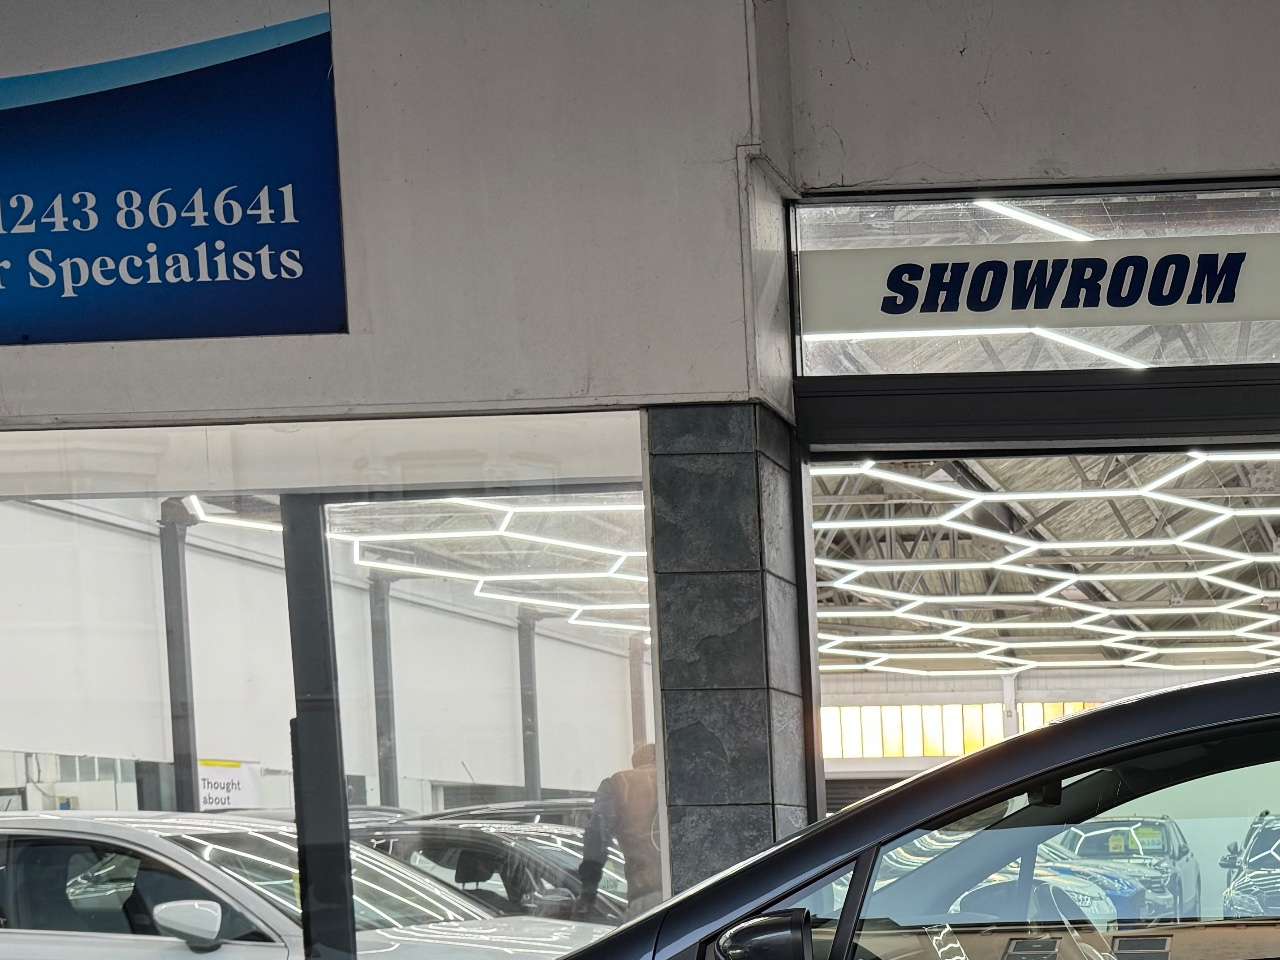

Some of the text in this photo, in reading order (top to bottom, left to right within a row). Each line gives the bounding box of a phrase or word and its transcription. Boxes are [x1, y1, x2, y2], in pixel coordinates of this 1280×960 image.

[116, 183, 300, 230] 864641
[28, 240, 304, 298] Specialists
[880, 252, 1247, 315] SHOWROOM
[201, 778, 241, 793] Thought
[202, 793, 231, 806] about
